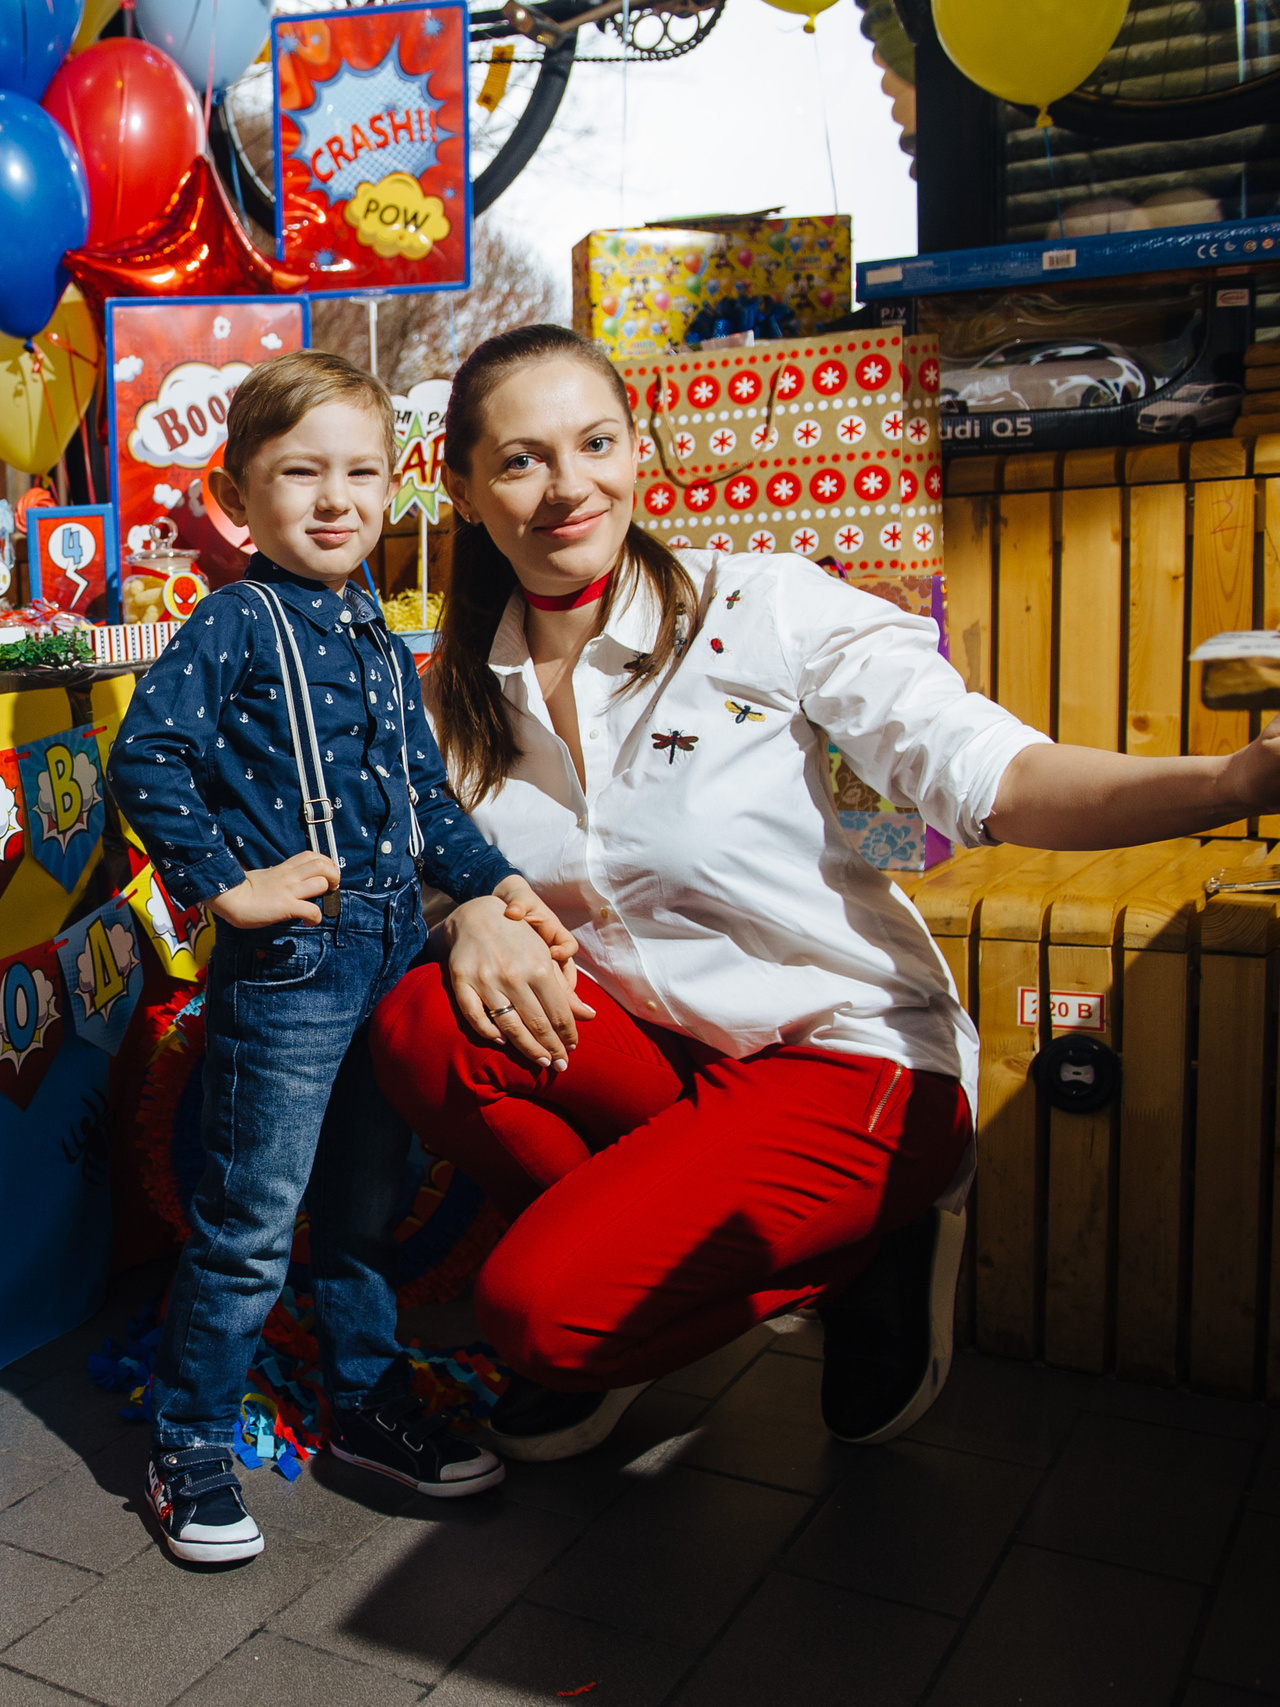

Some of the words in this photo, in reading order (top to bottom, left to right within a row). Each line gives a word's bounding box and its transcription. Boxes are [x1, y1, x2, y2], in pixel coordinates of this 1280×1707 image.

[310, 108, 438, 183] CRASH!!
[363, 200, 431, 231] POW
[153, 386, 239, 452] Boo
[940, 419, 981, 440] udi
[992, 416, 1033, 438] Q5
[61, 528, 84, 565] 4
